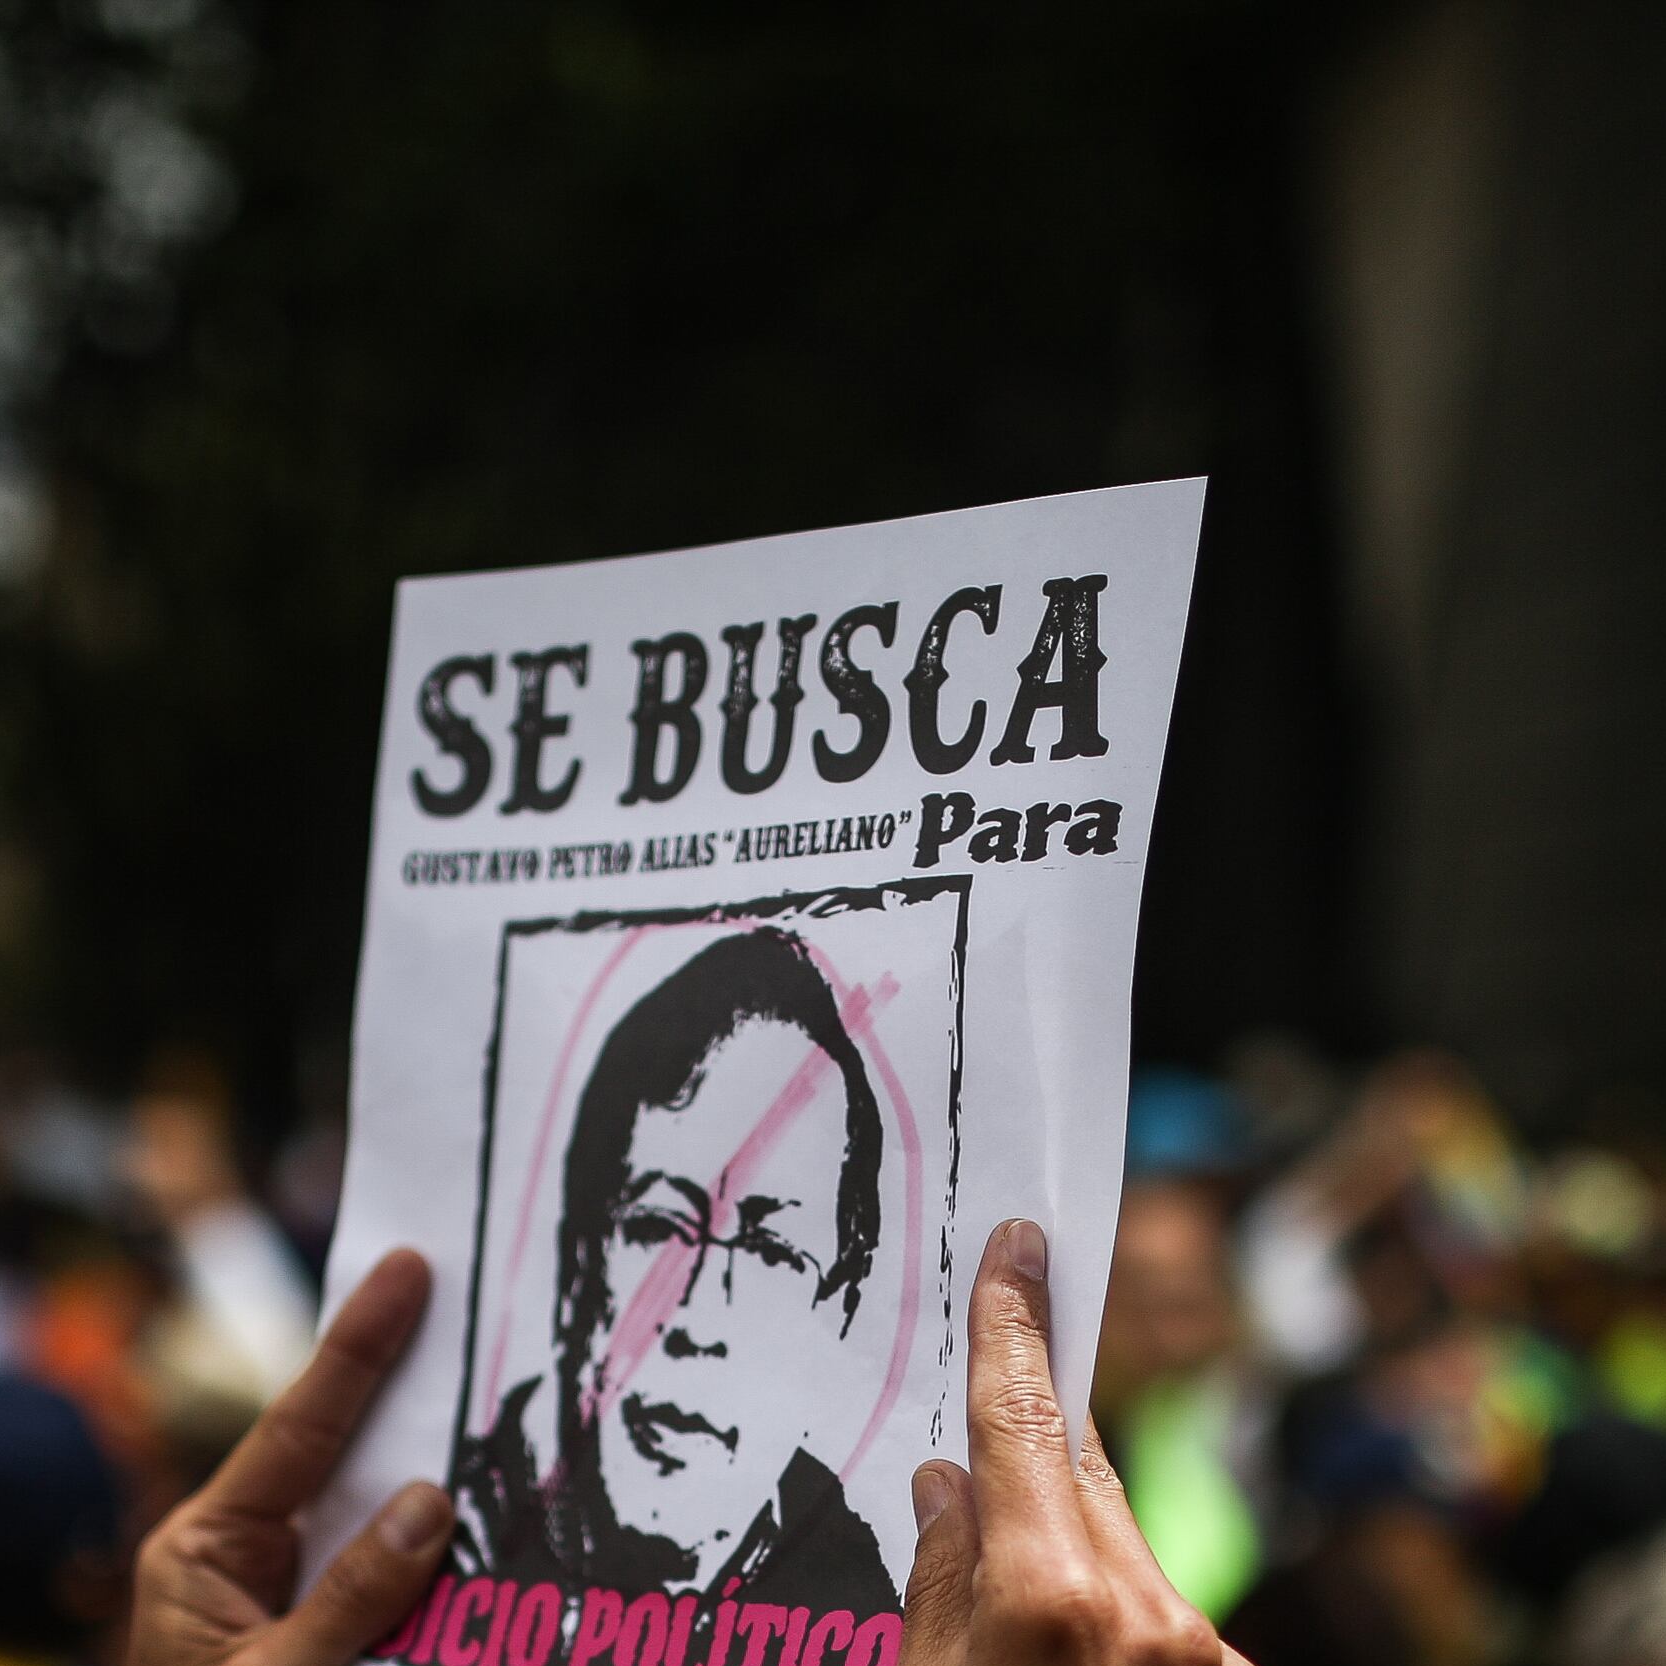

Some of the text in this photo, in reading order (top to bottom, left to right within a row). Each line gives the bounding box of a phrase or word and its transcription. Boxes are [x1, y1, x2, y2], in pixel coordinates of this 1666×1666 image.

[408, 574, 1110, 818] SE BUSCA
[403, 850, 539, 885] GUSTAVO
[548, 842, 632, 880] PETRO
[641, 833, 718, 872] ALIAS
[913, 791, 1124, 868] Para
